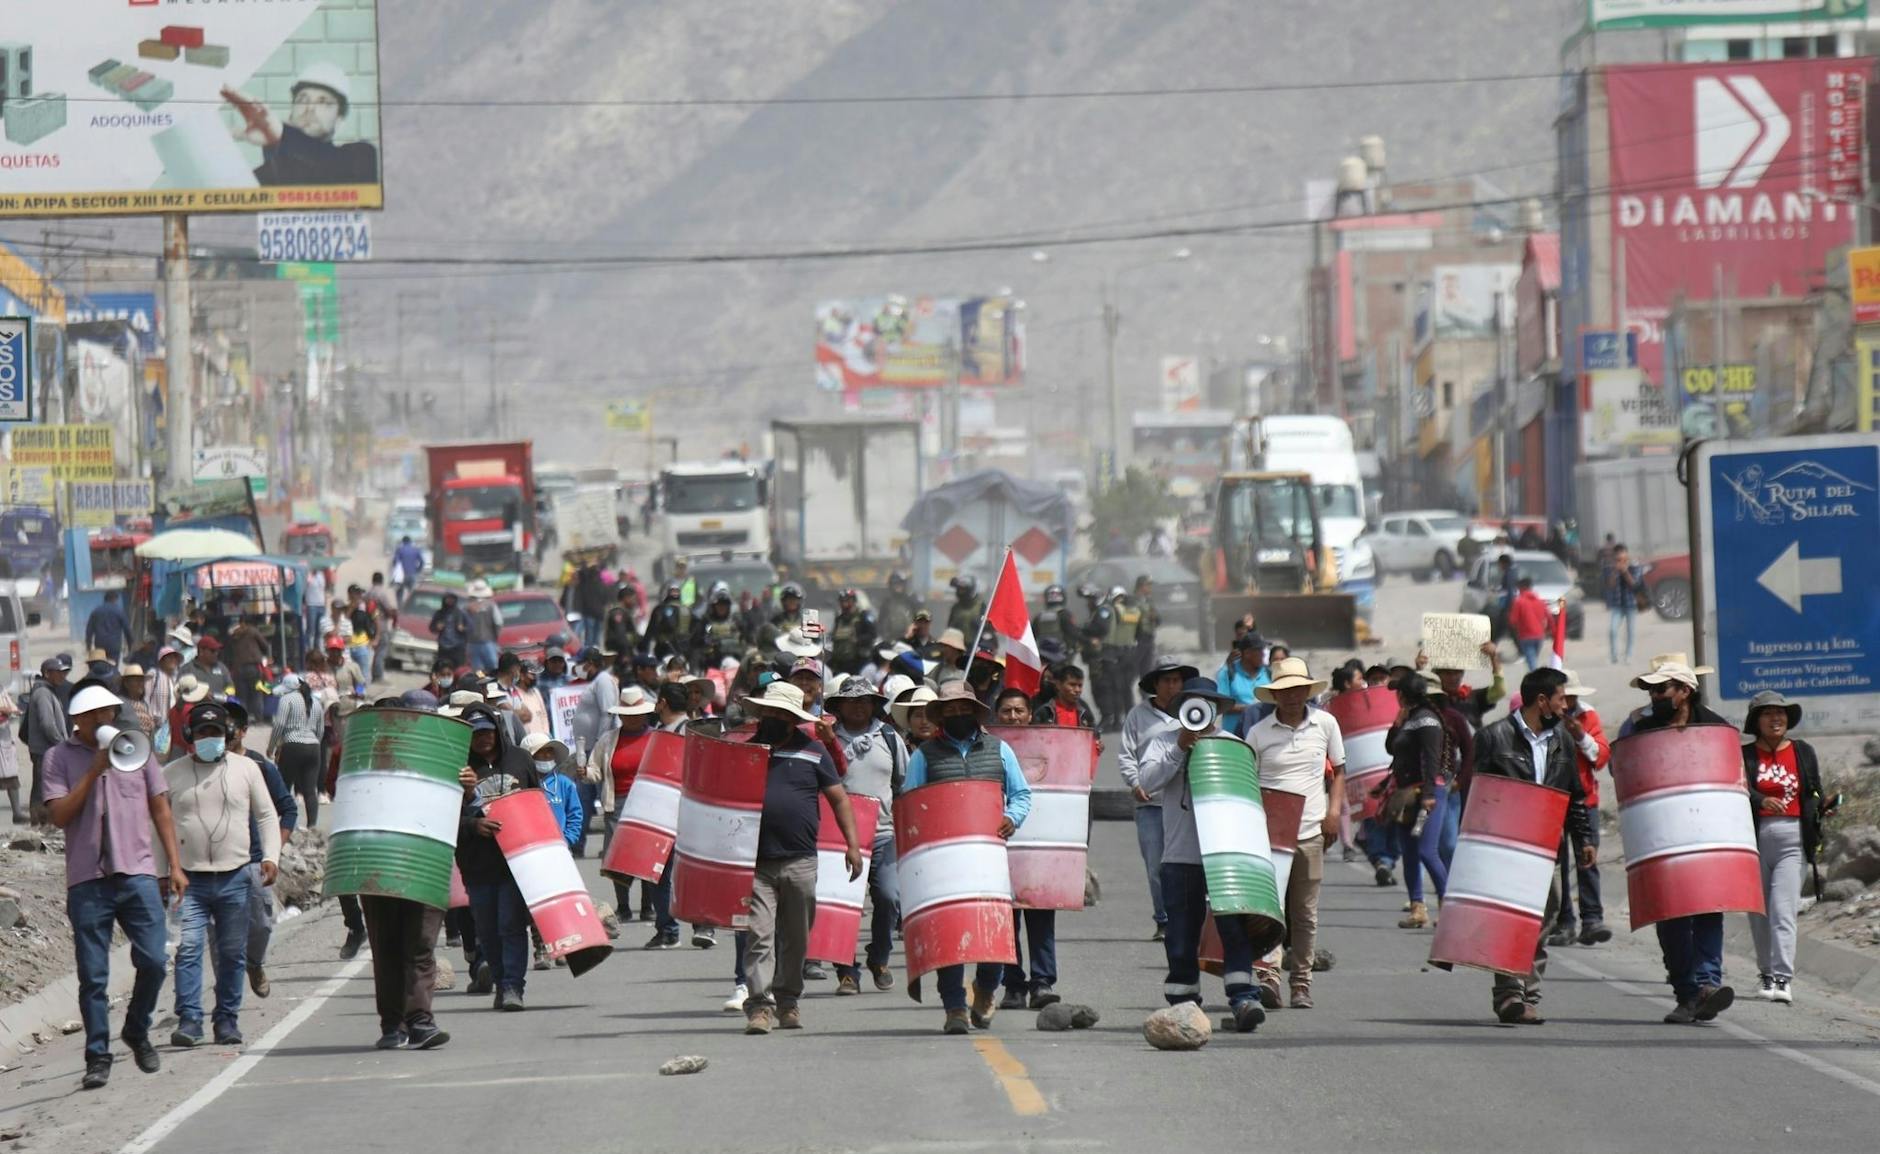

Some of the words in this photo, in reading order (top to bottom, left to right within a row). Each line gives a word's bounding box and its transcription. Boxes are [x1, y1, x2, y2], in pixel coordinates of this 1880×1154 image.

[90, 115, 173, 127] ADOQUINES
[24, 198, 68, 209] APIPA
[72, 196, 127, 208] SECTOR
[162, 194, 183, 206] MZ
[204, 193, 274, 205] CELULAR:
[263, 213, 363, 226] DISPONIBLE
[1679, 225, 1809, 242] LADRILLOS
[260, 226, 369, 260] 958088234
[13, 428, 55, 448] CAMBIO
[59, 429, 71, 447] DE
[76, 428, 110, 447] ACEITE
[1750, 641, 1802, 656] Ingreso
[1804, 644, 1813, 652] a
[1815, 643, 1830, 653] 14
[1832, 637, 1860, 649] km.
[1754, 665, 1803, 677] Canteras
[1738, 679, 1793, 693] Quebrada
[1795, 679, 1808, 688] de
[1811, 676, 1871, 688] Culebrillas
